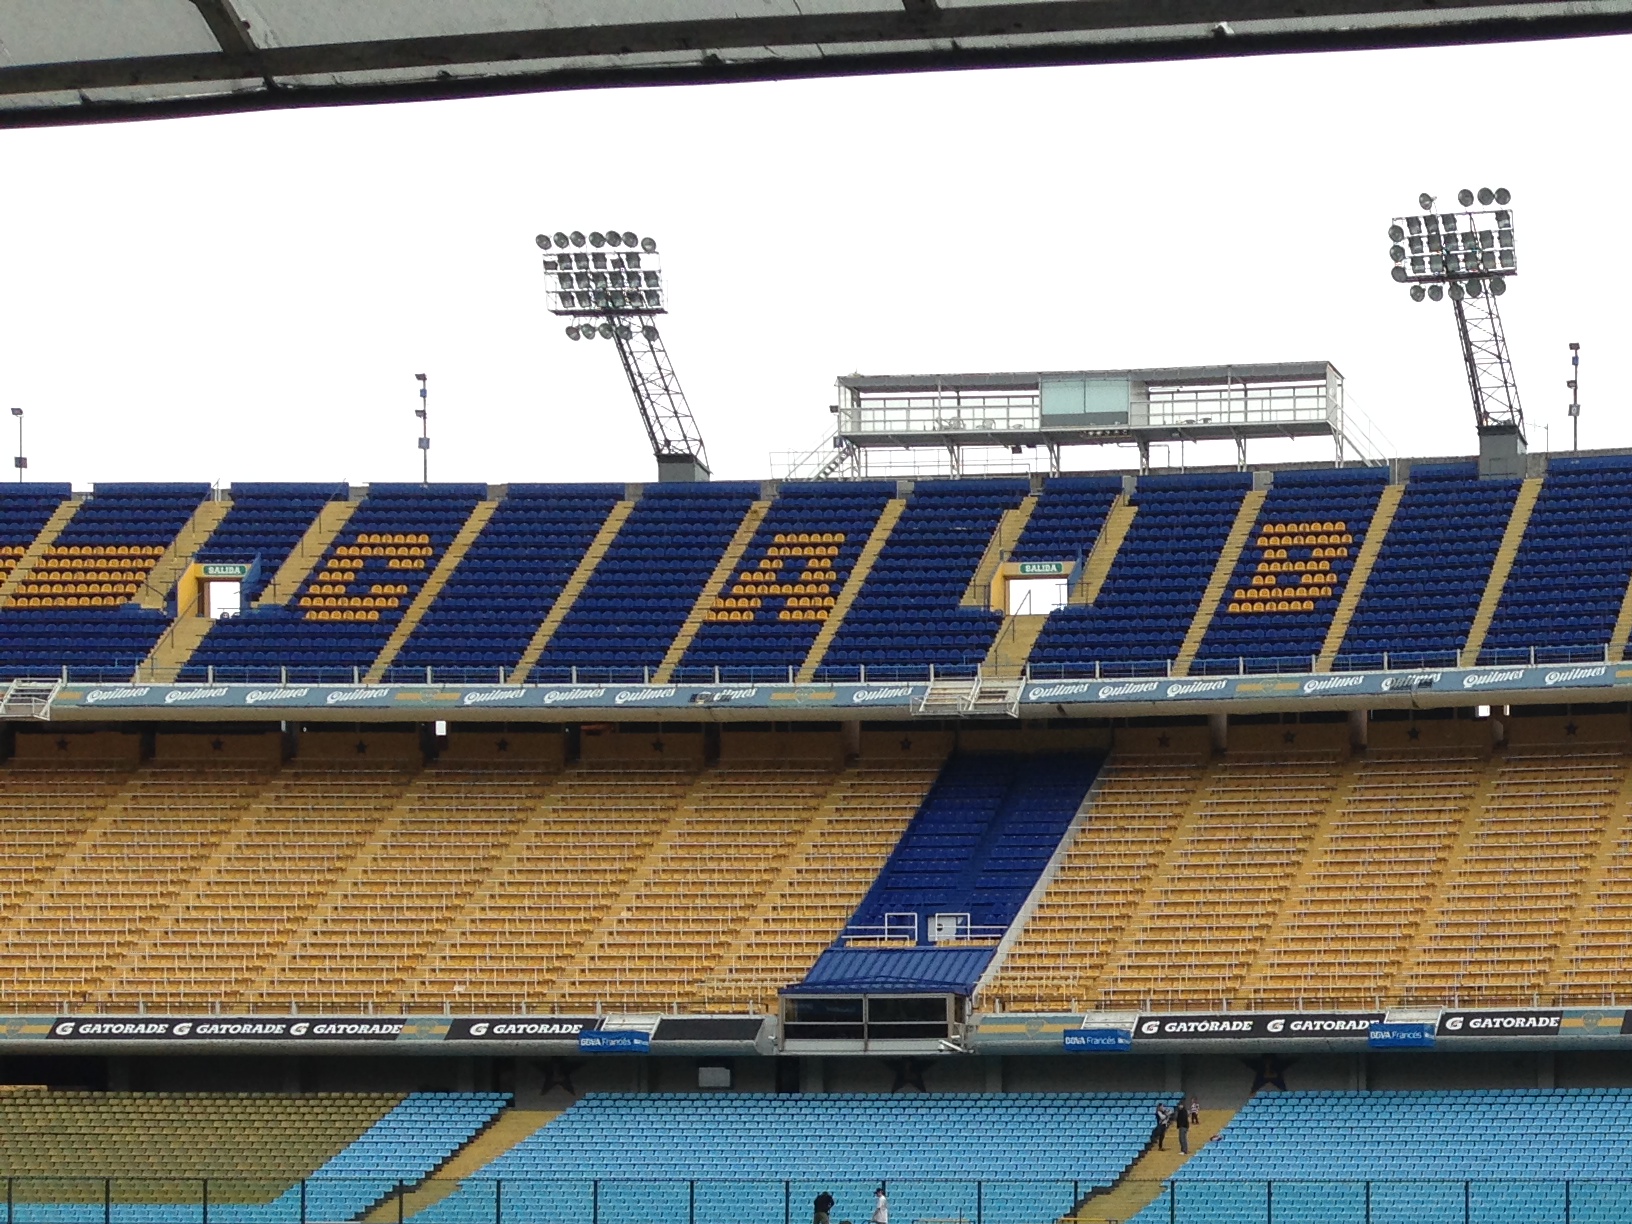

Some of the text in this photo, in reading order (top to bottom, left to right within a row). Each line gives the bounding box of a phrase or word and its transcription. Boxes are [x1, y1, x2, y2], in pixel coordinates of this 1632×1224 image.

[208, 566, 241, 575] SALIDA
[1025, 563, 1057, 573] SALIDA
[1304, 675, 1364, 693] Quilmes
[1463, 670, 1524, 689] Quilmes
[1545, 667, 1606, 686] Quilmes
[86, 686, 151, 704] Quilmes
[164, 687, 229, 704] Quilmes
[245, 687, 310, 704] Quilmes
[326, 687, 390, 704] Quilmes
[464, 688, 527, 705] Quilmes
[544, 688, 606, 705] Quilmes
[614, 688, 676, 705] Quilmes
[853, 687, 914, 703] Quilmes
[1029, 683, 1090, 700] Quilmes
[1099, 681, 1159, 699] Quilmes
[1166, 679, 1227, 698] Quilmes
[79, 1023, 169, 1035] GATORADE
[196, 1023, 287, 1035] GATORADE
[313, 1023, 404, 1035] GATORADE
[493, 1024, 584, 1035] GATORADE
[1164, 1020, 1254, 1033] GATORADE
[1469, 1015, 1560, 1029] GATORADE
